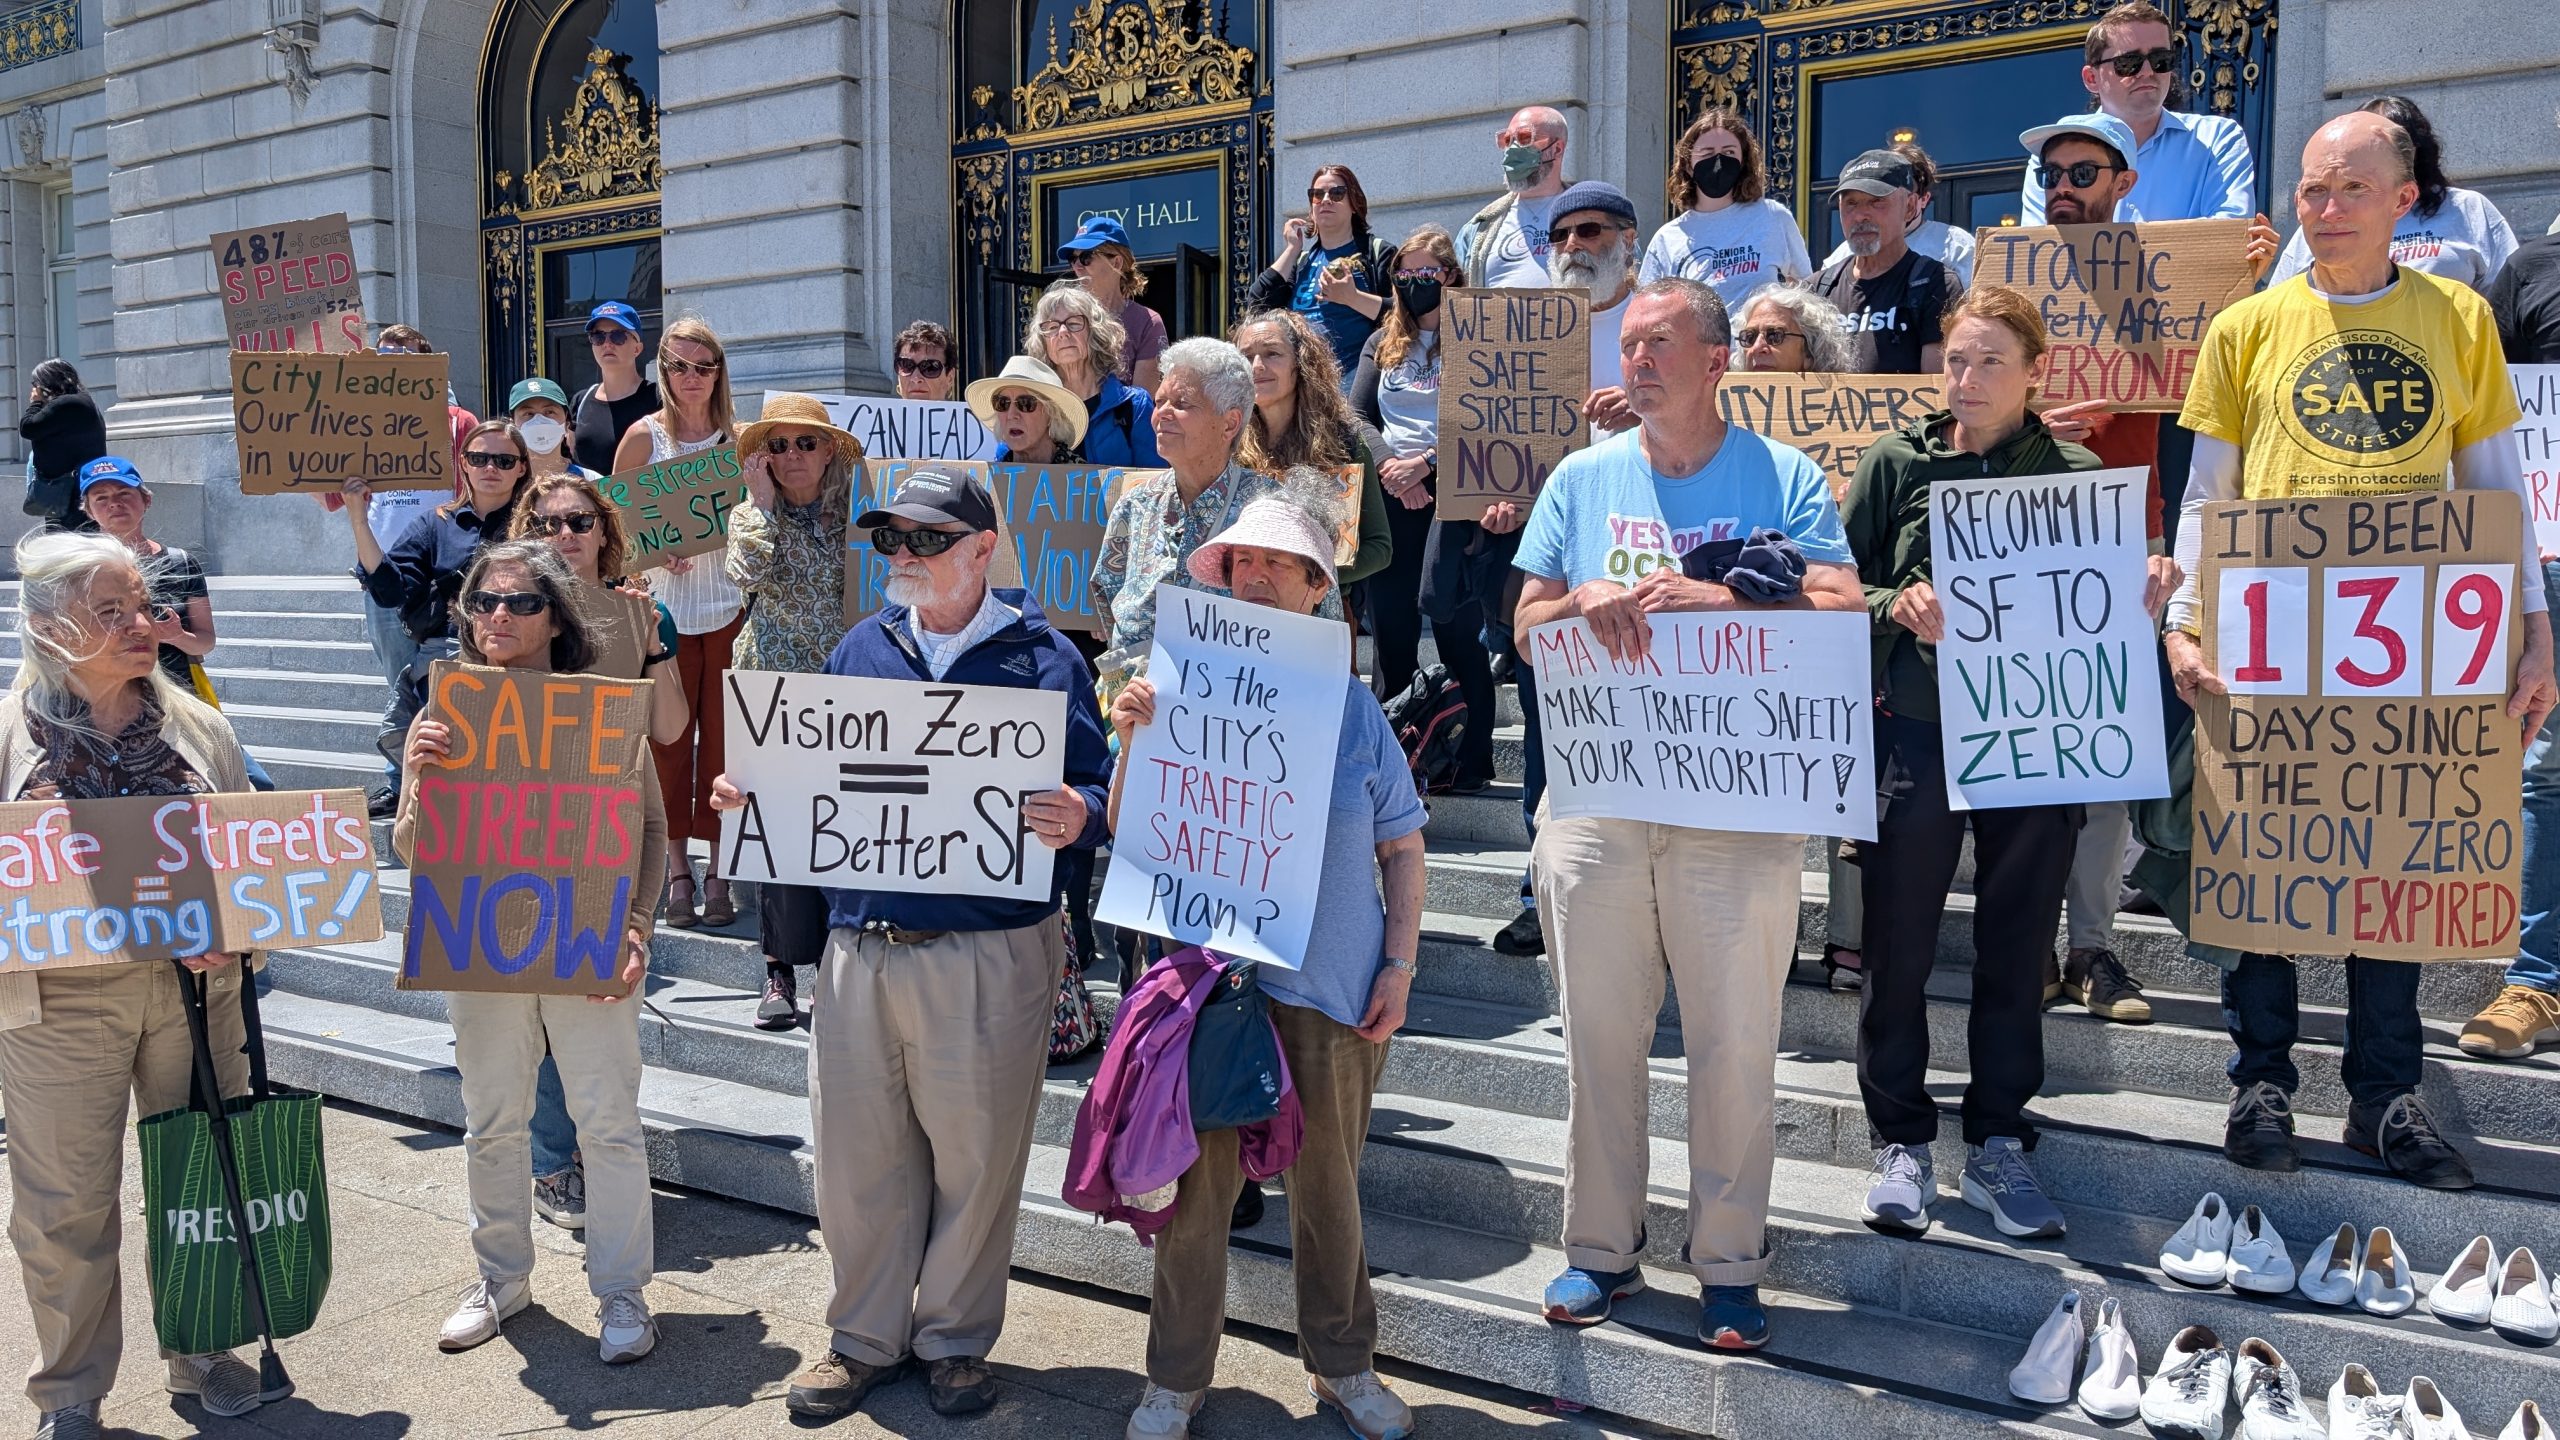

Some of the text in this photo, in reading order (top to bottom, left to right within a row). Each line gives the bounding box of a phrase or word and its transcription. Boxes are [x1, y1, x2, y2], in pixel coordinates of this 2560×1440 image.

[1137, 200, 1199, 228] HALL
[2392, 231, 2422, 242] NIOR
[223, 231, 288, 268] 48%
[310, 230, 350, 249] cars
[1712, 252, 1760, 269] DISABILITY
[1714, 246, 1745, 259] SENIOR
[1714, 261, 1760, 280] ACTION
[1994, 230, 2171, 294] Traffic
[2390, 236, 2444, 250] SABILITY
[2391, 244, 2441, 264] CTION
[225, 252, 353, 305] SPEED
[1449, 295, 1577, 343] WE NEED
[2041, 294, 2222, 346] fety Affect
[241, 358, 443, 413] City leaders:
[1468, 350, 1549, 392] SAFE
[2042, 343, 2201, 403] ERYONE
[2286, 333, 2431, 384] SAN FRANCISCO BAY ARE
[2310, 348, 2415, 380] FAMILIES
[2349, 367, 2374, 375] FOR
[239, 400, 429, 440] Our lives are
[1458, 393, 1579, 437] STREETS
[1720, 385, 1776, 437] ITY
[2301, 380, 2426, 416] SAFE
[2316, 419, 2415, 448] STREETS
[246, 441, 443, 487] in your hands
[637, 449, 743, 498] streets
[2289, 472, 2440, 485] #crashnotaccident
[381, 498, 421, 507] ANYWHERE
[1941, 482, 2128, 562] RECOMMIT
[2217, 503, 2327, 559] IT'S
[2348, 495, 2475, 557] BEEN
[1610, 517, 1733, 554] YES on K
[1016, 529, 1094, 616] VIOL
[1184, 598, 1271, 655] Where
[1949, 568, 2111, 643] SF TO
[1675, 621, 1793, 677] LURIE:
[1179, 658, 1278, 713] IS the
[1956, 641, 2128, 722] VISION
[437, 671, 633, 774] SAFE
[728, 674, 1046, 759] Vision Zero
[1544, 685, 1858, 745] MAKE TRAFFIC SAFETY
[2229, 703, 2500, 758] DAYS SINCE
[1169, 704, 1287, 784] CITY'S
[1553, 739, 1644, 788] YOUR
[1957, 723, 2133, 786] ZERO
[1149, 758, 1295, 842] TRAFFIC
[2222, 761, 2482, 819] THE CITY'S
[0, 793, 368, 888] afe Streets
[417, 776, 639, 868] STREETS
[728, 785, 1053, 885] A Better SF
[2199, 810, 2512, 874] VISION ZERO
[1144, 812, 1281, 893] SAFETY
[0, 869, 373, 966] trong SF!
[405, 873, 632, 980] NOW
[2194, 866, 2516, 948] POLICY EXPIRED
